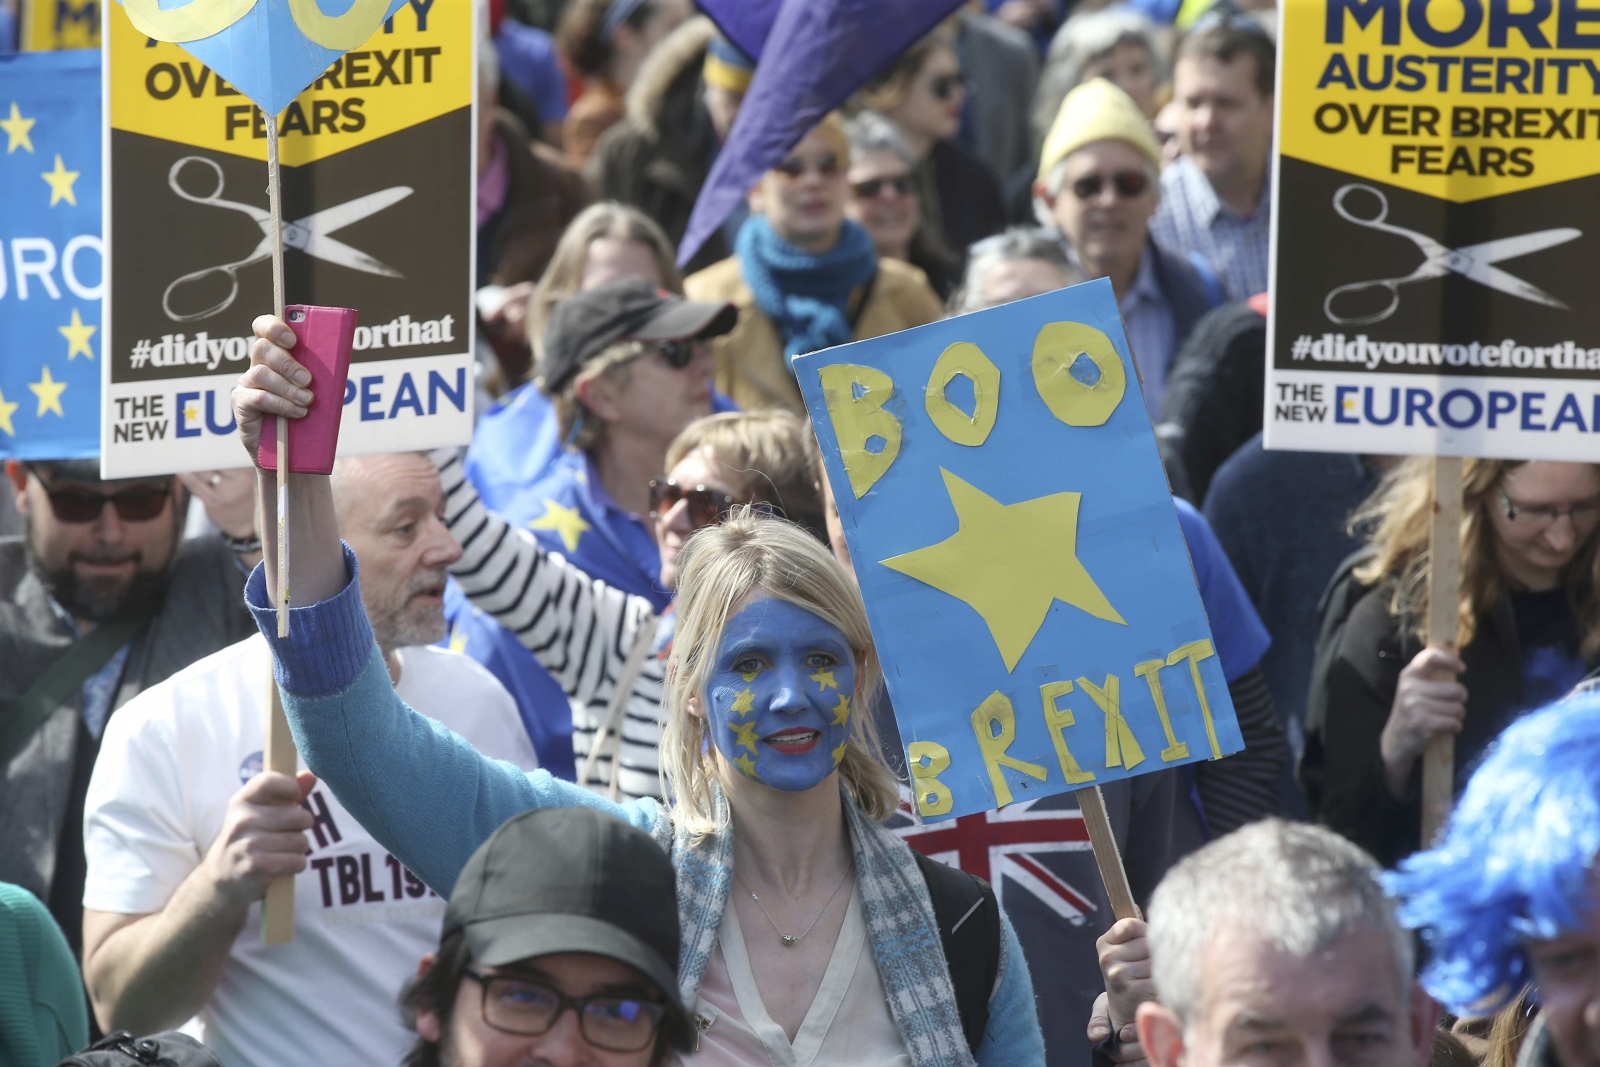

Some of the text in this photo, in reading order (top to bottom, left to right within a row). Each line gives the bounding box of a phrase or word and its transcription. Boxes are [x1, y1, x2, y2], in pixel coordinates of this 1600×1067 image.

[1324, 0, 1600, 49] MORE
[301, 46, 442, 91] REXIT
[1314, 102, 1440, 137] OVER
[1391, 144, 1535, 178] FEARS
[1291, 333, 1600, 370] #didyouvotefortha
[114, 395, 164, 420] THE
[818, 321, 1126, 499] BOO
[1276, 383, 1323, 402] THE
[114, 419, 169, 443] NEW
[1275, 404, 1328, 423] NEW
[908, 638, 1222, 817] BREXIT
[311, 853, 437, 909] TBL 19
